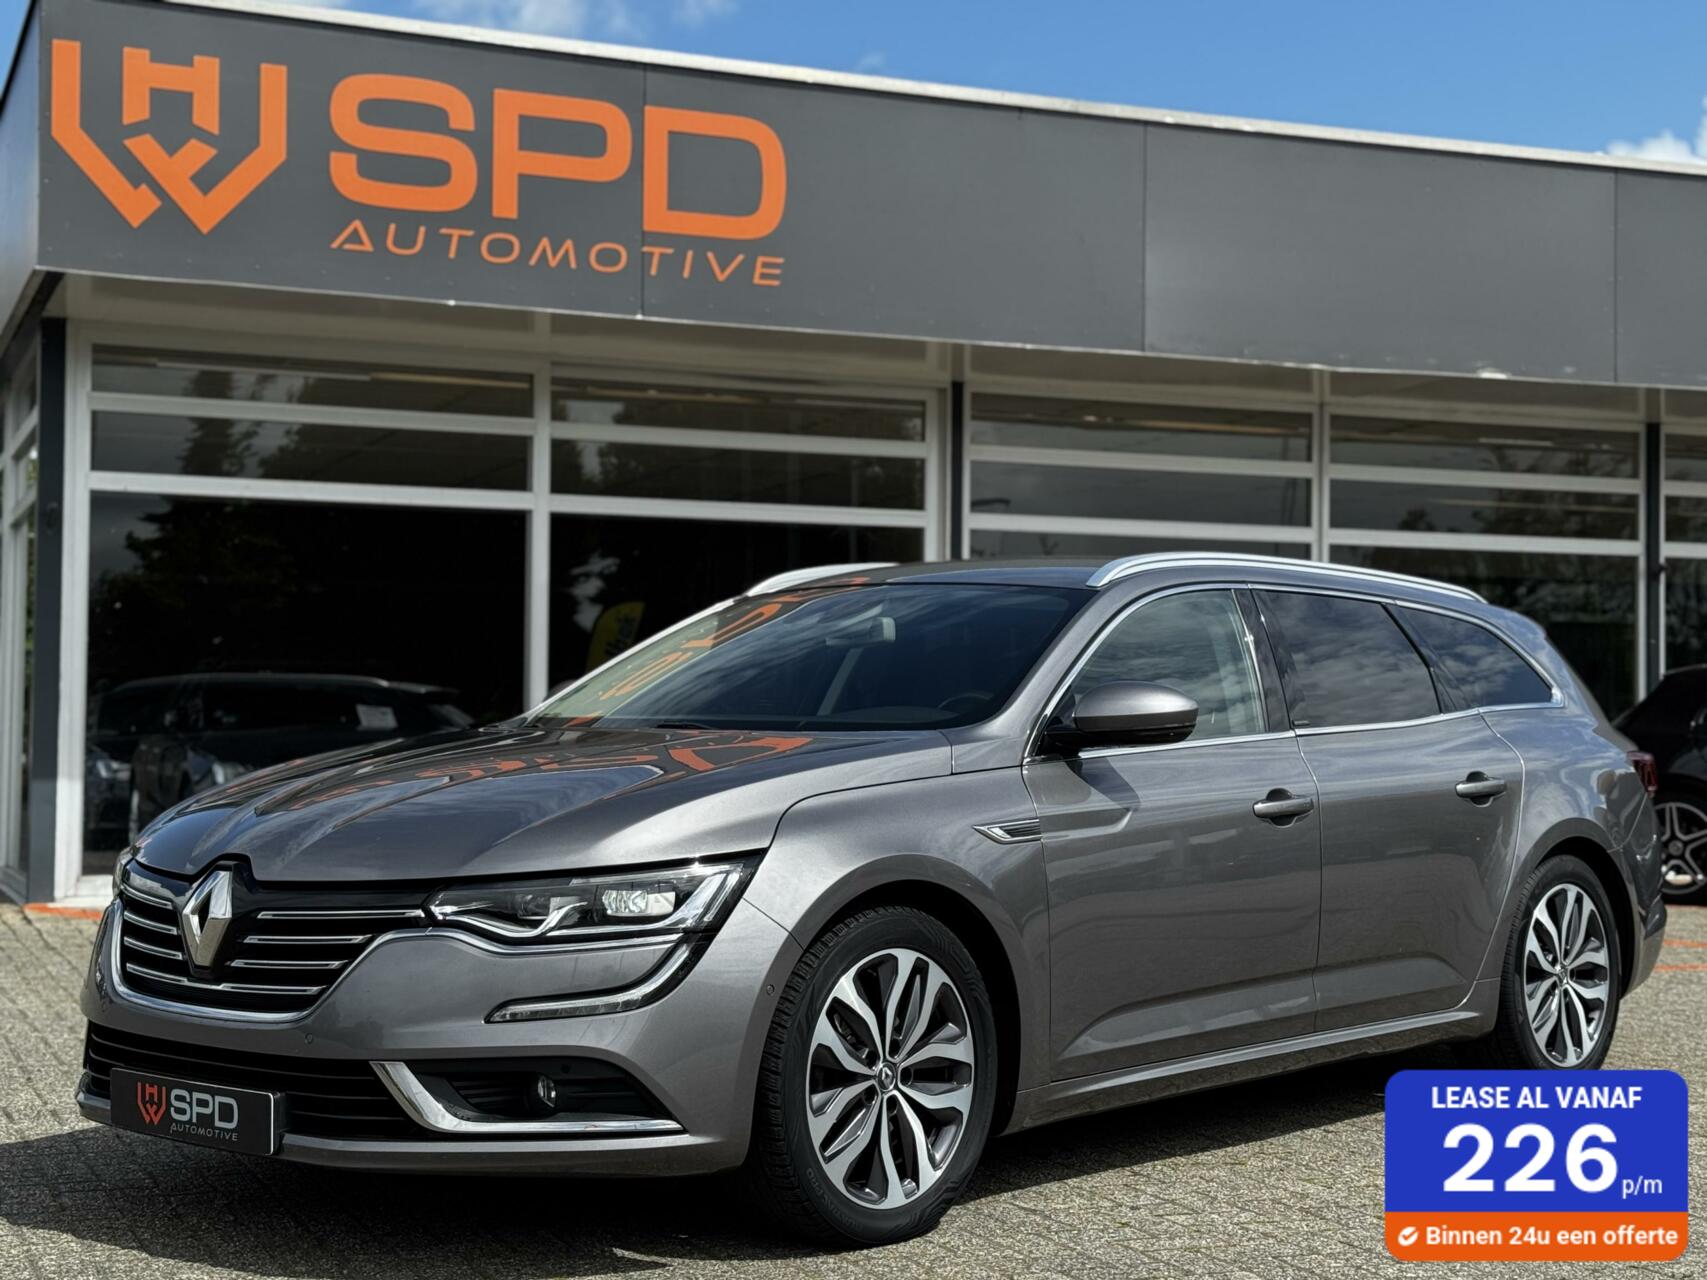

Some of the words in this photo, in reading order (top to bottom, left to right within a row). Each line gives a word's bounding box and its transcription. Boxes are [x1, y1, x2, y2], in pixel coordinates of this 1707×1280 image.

[330, 73, 787, 241] SPD
[331, 219, 787, 287] AUTOMOTIVE
[169, 1122, 239, 1142] AUTOMOTIVE
[170, 1088, 239, 1130] SPD
